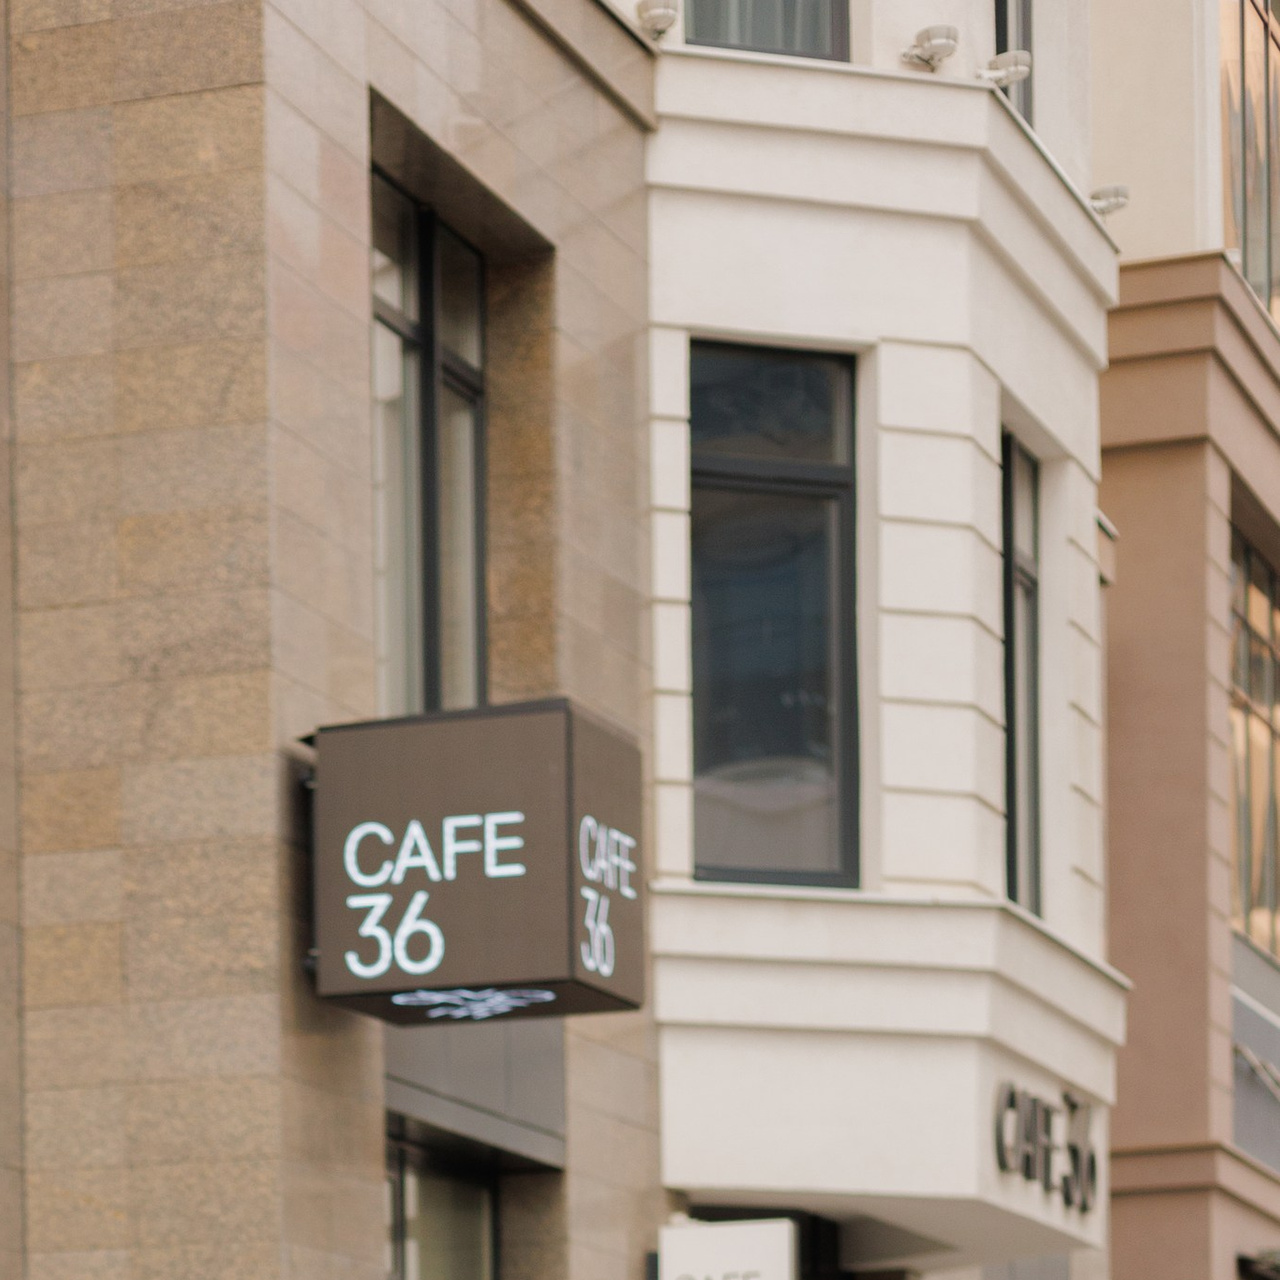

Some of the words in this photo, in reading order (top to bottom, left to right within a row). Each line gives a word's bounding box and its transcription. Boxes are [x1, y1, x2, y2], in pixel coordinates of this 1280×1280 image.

[343, 811, 526, 887] CAFE
[579, 815, 637, 899] CAFE
[344, 890, 445, 979] 36
[580, 886, 615, 977] 36
